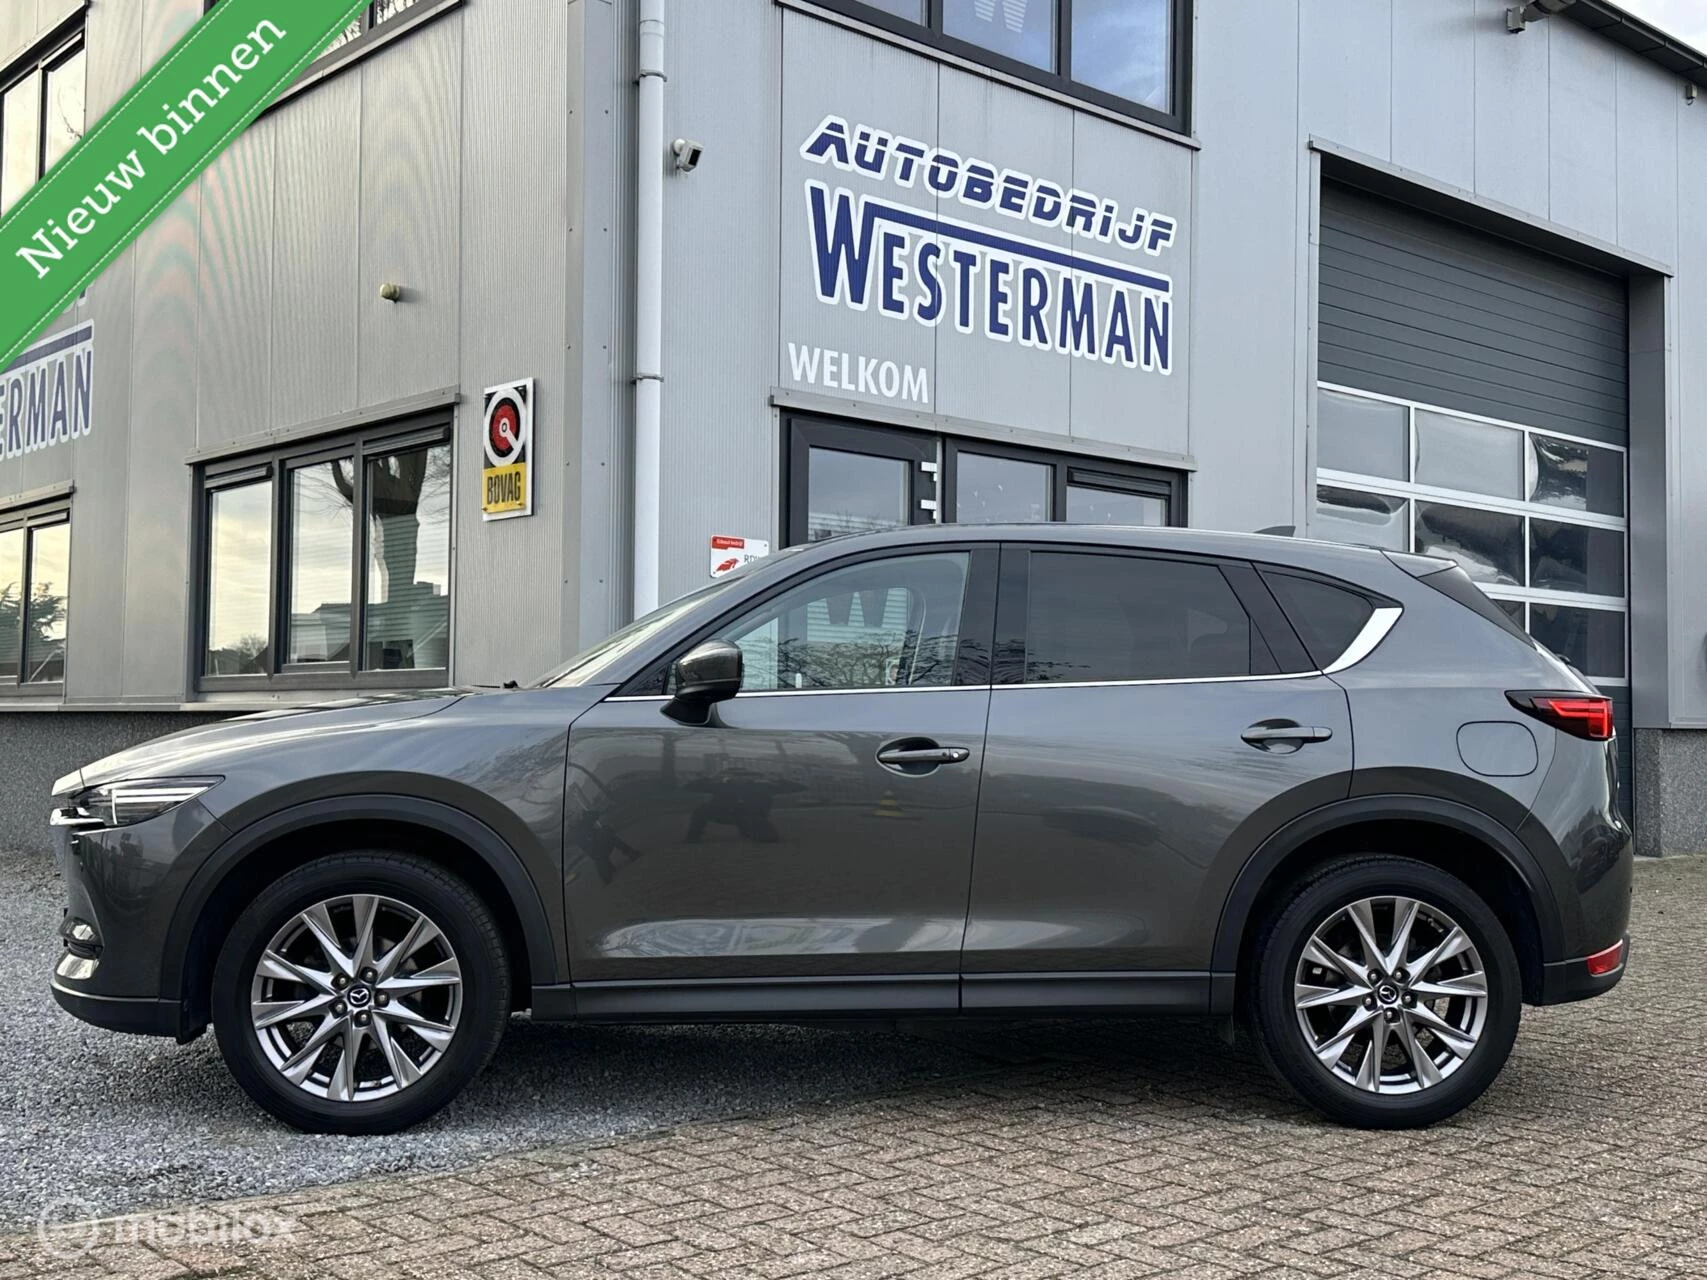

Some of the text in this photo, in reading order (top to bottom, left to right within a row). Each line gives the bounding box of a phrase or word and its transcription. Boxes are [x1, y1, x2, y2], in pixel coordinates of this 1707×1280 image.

[803, 118, 1175, 253] AUTOBEDRIJF
[805, 181, 1173, 372] WESTERMAN
[788, 342, 929, 403] WELKOM
[487, 471, 521, 505] BOVAG
